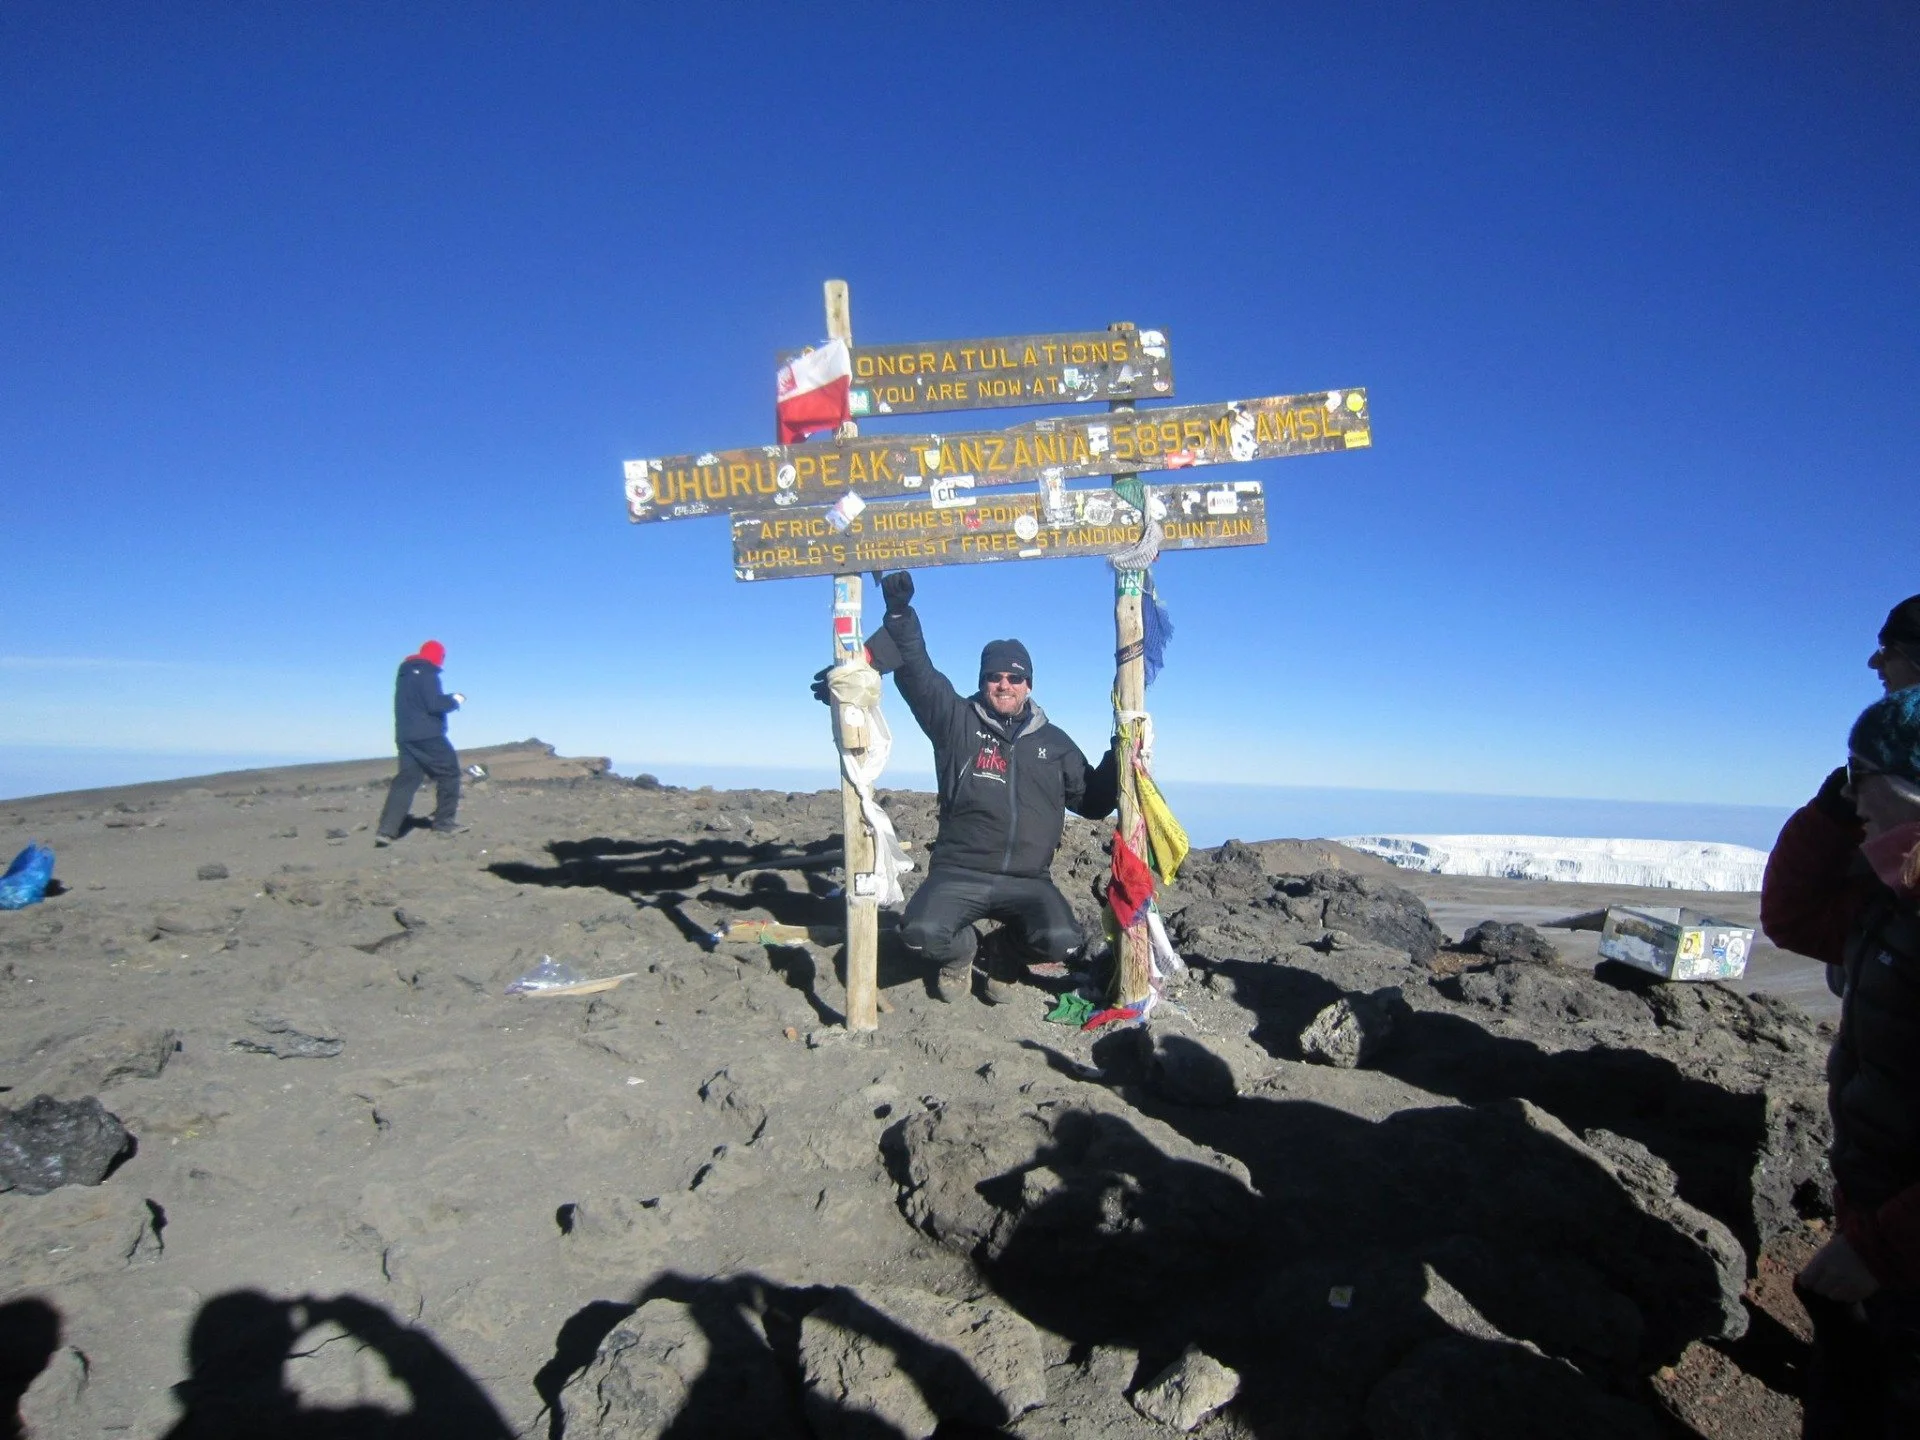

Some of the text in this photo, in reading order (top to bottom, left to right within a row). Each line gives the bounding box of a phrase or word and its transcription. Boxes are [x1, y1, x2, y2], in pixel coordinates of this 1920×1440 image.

[872, 385, 915, 404] YOU
[926, 382, 968, 402] ARE
[978, 378, 1022, 398] NOW
[1033, 376, 1058, 396] AT
[651, 460, 777, 505] UHURU
[794, 448, 904, 489] PEAK,
[1113, 415, 1232, 460] 5895M
[1256, 405, 1342, 444] AMSL
[873, 506, 967, 532] HIGHEST
[978, 503, 1040, 525] POINT
[746, 519, 1253, 568] WORLD'S HIGHEST FREE STANDING OUNTAIN
